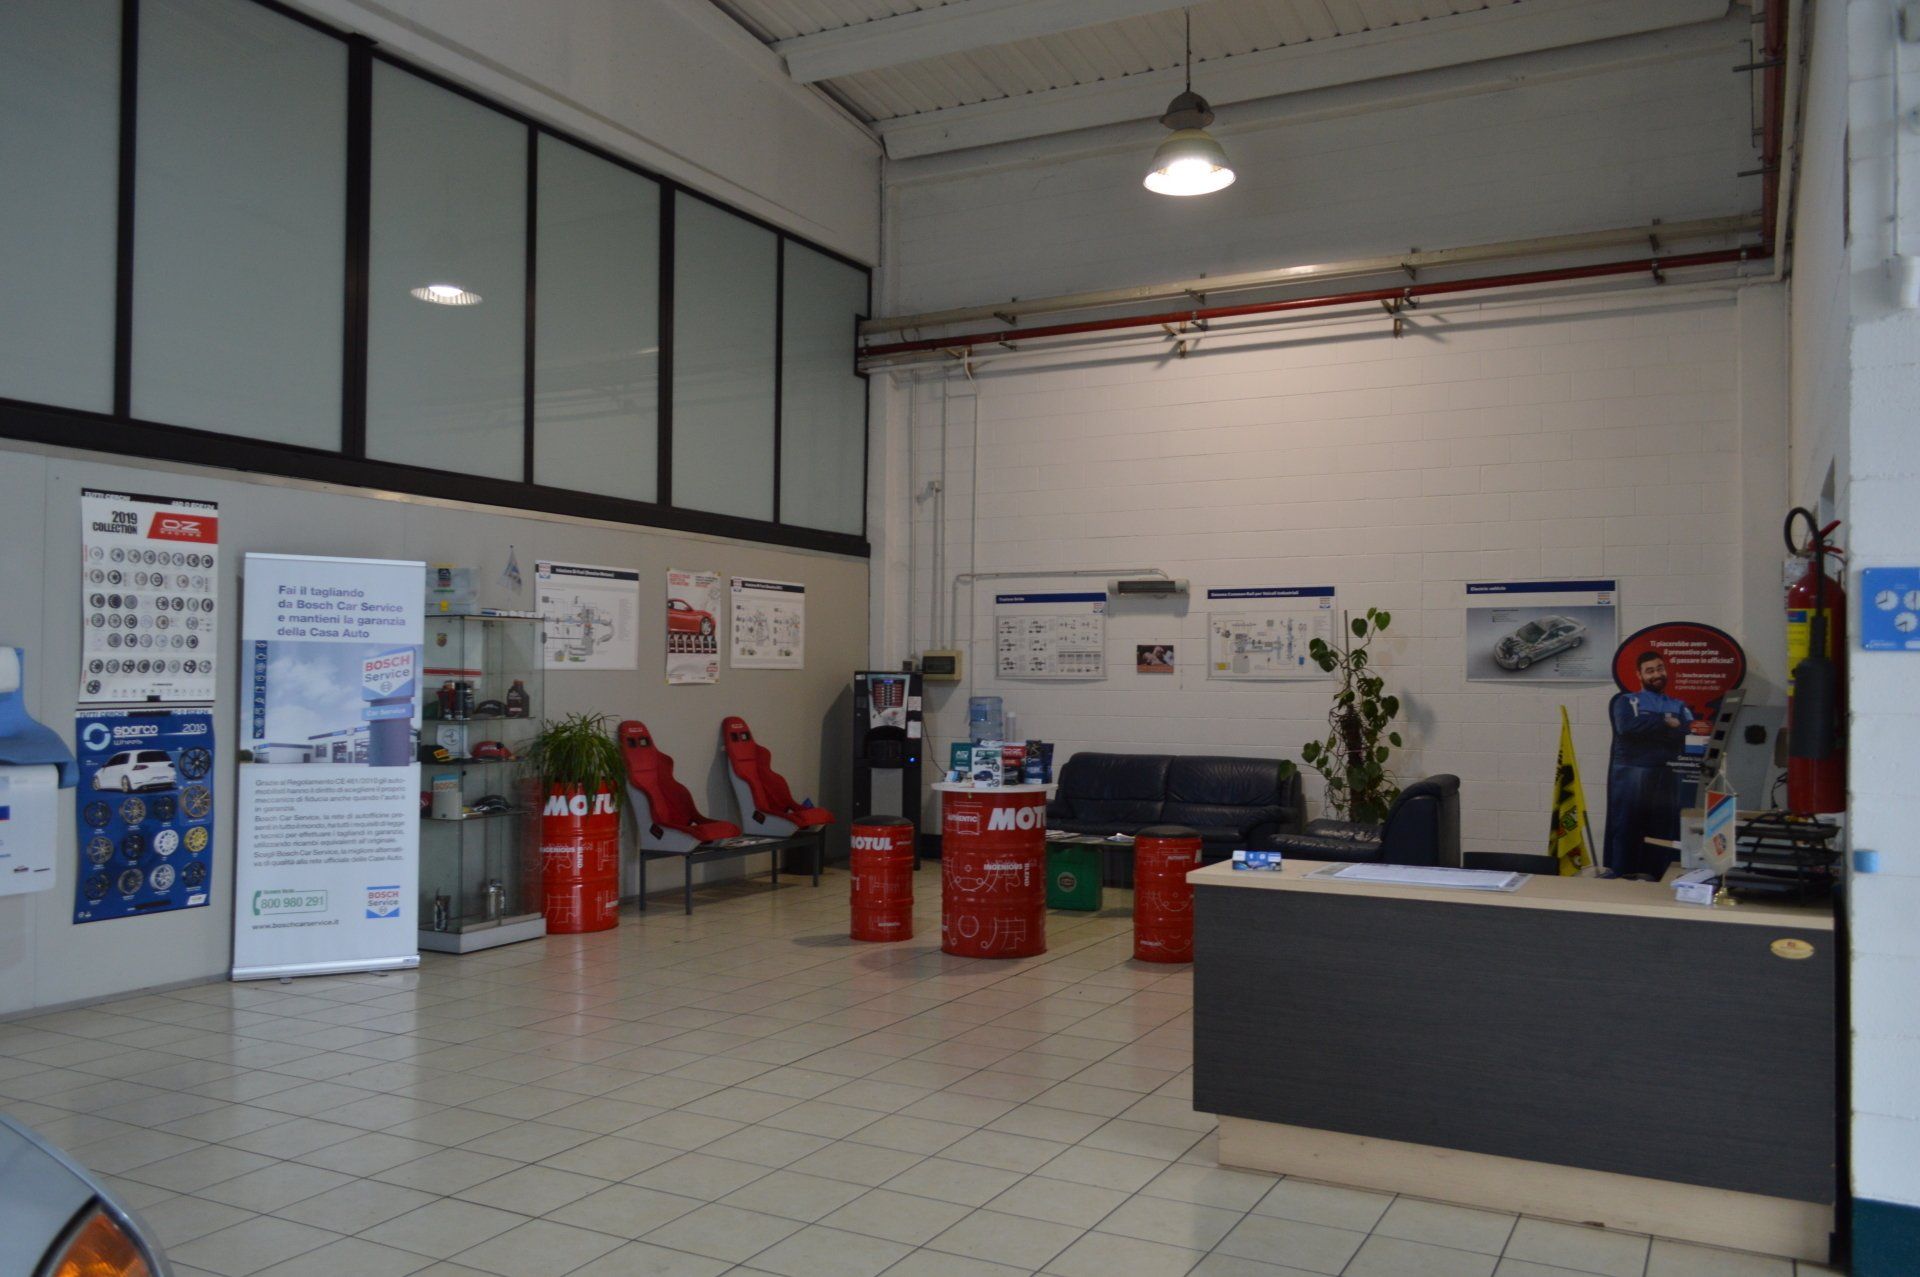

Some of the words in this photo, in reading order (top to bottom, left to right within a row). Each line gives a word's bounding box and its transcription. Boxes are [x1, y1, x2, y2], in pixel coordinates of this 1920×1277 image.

[112, 510, 138, 524] 2019
[92, 522, 138, 535] COLLECTION
[161, 519, 201, 531] OZ
[278, 585, 296, 595] Fai
[300, 586, 307, 595] il
[311, 587, 364, 598] tagliando
[278, 600, 293, 608] da
[297, 600, 334, 610] Bosch
[336, 602, 358, 611] Car
[361, 602, 404, 612] Service
[289, 614, 340, 624] mantieni
[344, 615, 354, 624] la
[357, 616, 406, 626] garanzia
[277, 627, 306, 636] della
[310, 628, 339, 637] Casa
[342, 628, 370, 638] Auto
[365, 655, 410, 672] BOSCH
[365, 668, 410, 682] Service
[113, 725, 158, 738] sparco
[182, 724, 208, 734] 2019
[543, 793, 618, 816] MOTU
[368, 891, 399, 899] BOSCH
[260, 898, 280, 909] 800
[283, 897, 303, 908] 980
[305, 896, 323, 907] 291
